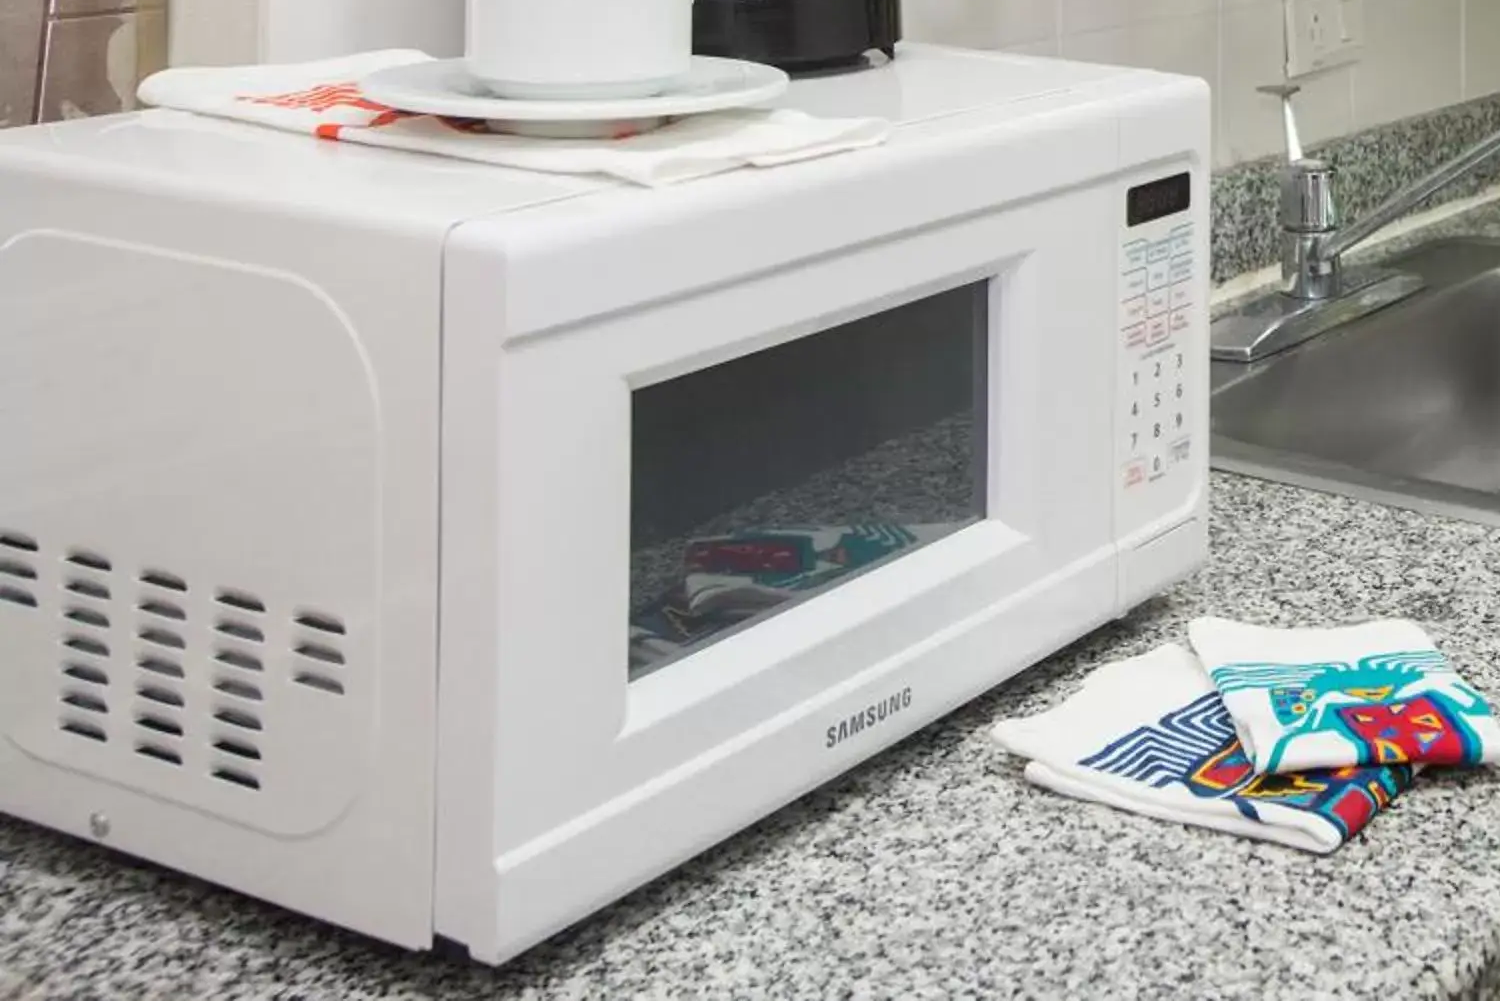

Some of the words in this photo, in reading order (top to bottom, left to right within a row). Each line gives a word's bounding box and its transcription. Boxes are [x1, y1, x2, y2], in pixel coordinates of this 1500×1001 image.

[1132, 371, 1139, 386] 1
[1153, 362, 1161, 378] 2
[1176, 353, 1183, 369] 3
[1131, 401, 1138, 417] 4
[1153, 392, 1161, 408] 5
[1176, 383, 1183, 399] 6
[1153, 422, 1161, 438] 8
[1175, 412, 1183, 428] 9
[1153, 455, 1161, 472] 0
[826, 687, 912, 748] SAMSUNG
